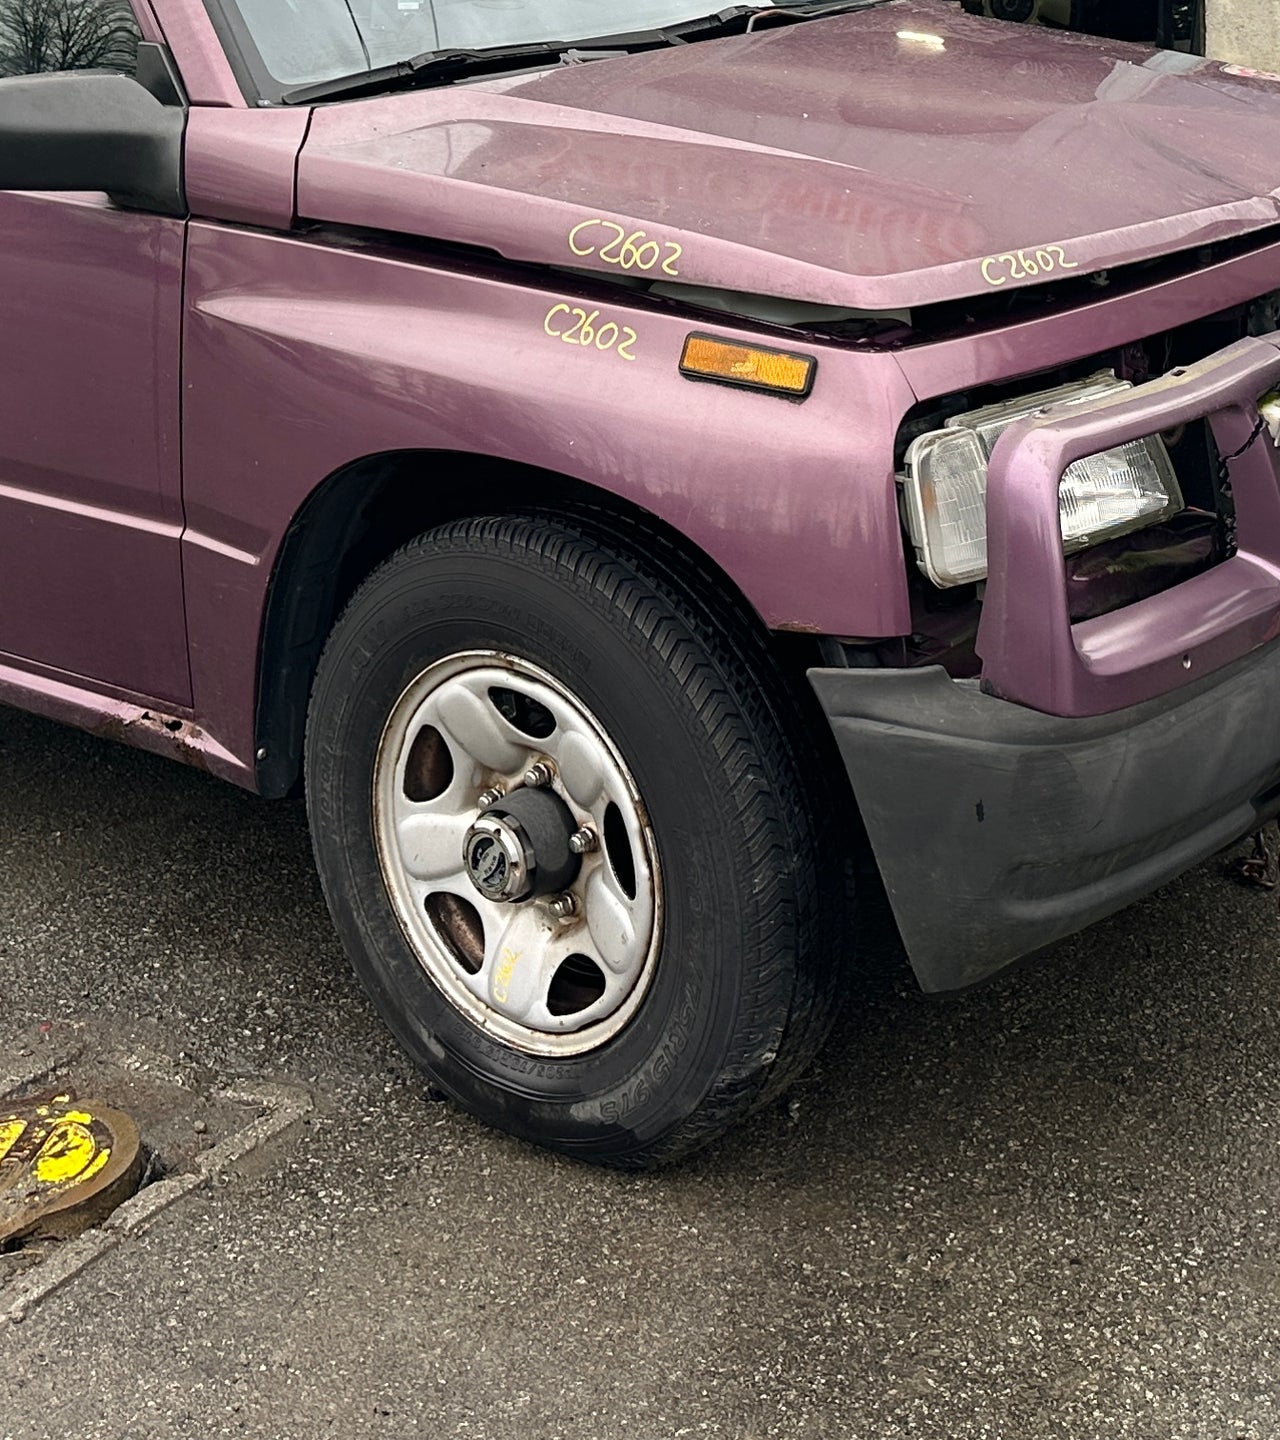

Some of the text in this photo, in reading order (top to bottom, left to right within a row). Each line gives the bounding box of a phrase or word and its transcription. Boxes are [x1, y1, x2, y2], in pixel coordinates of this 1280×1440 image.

[568, 218, 682, 276] C2602
[980, 246, 1078, 286] C2602
[543, 303, 637, 361] C2602
